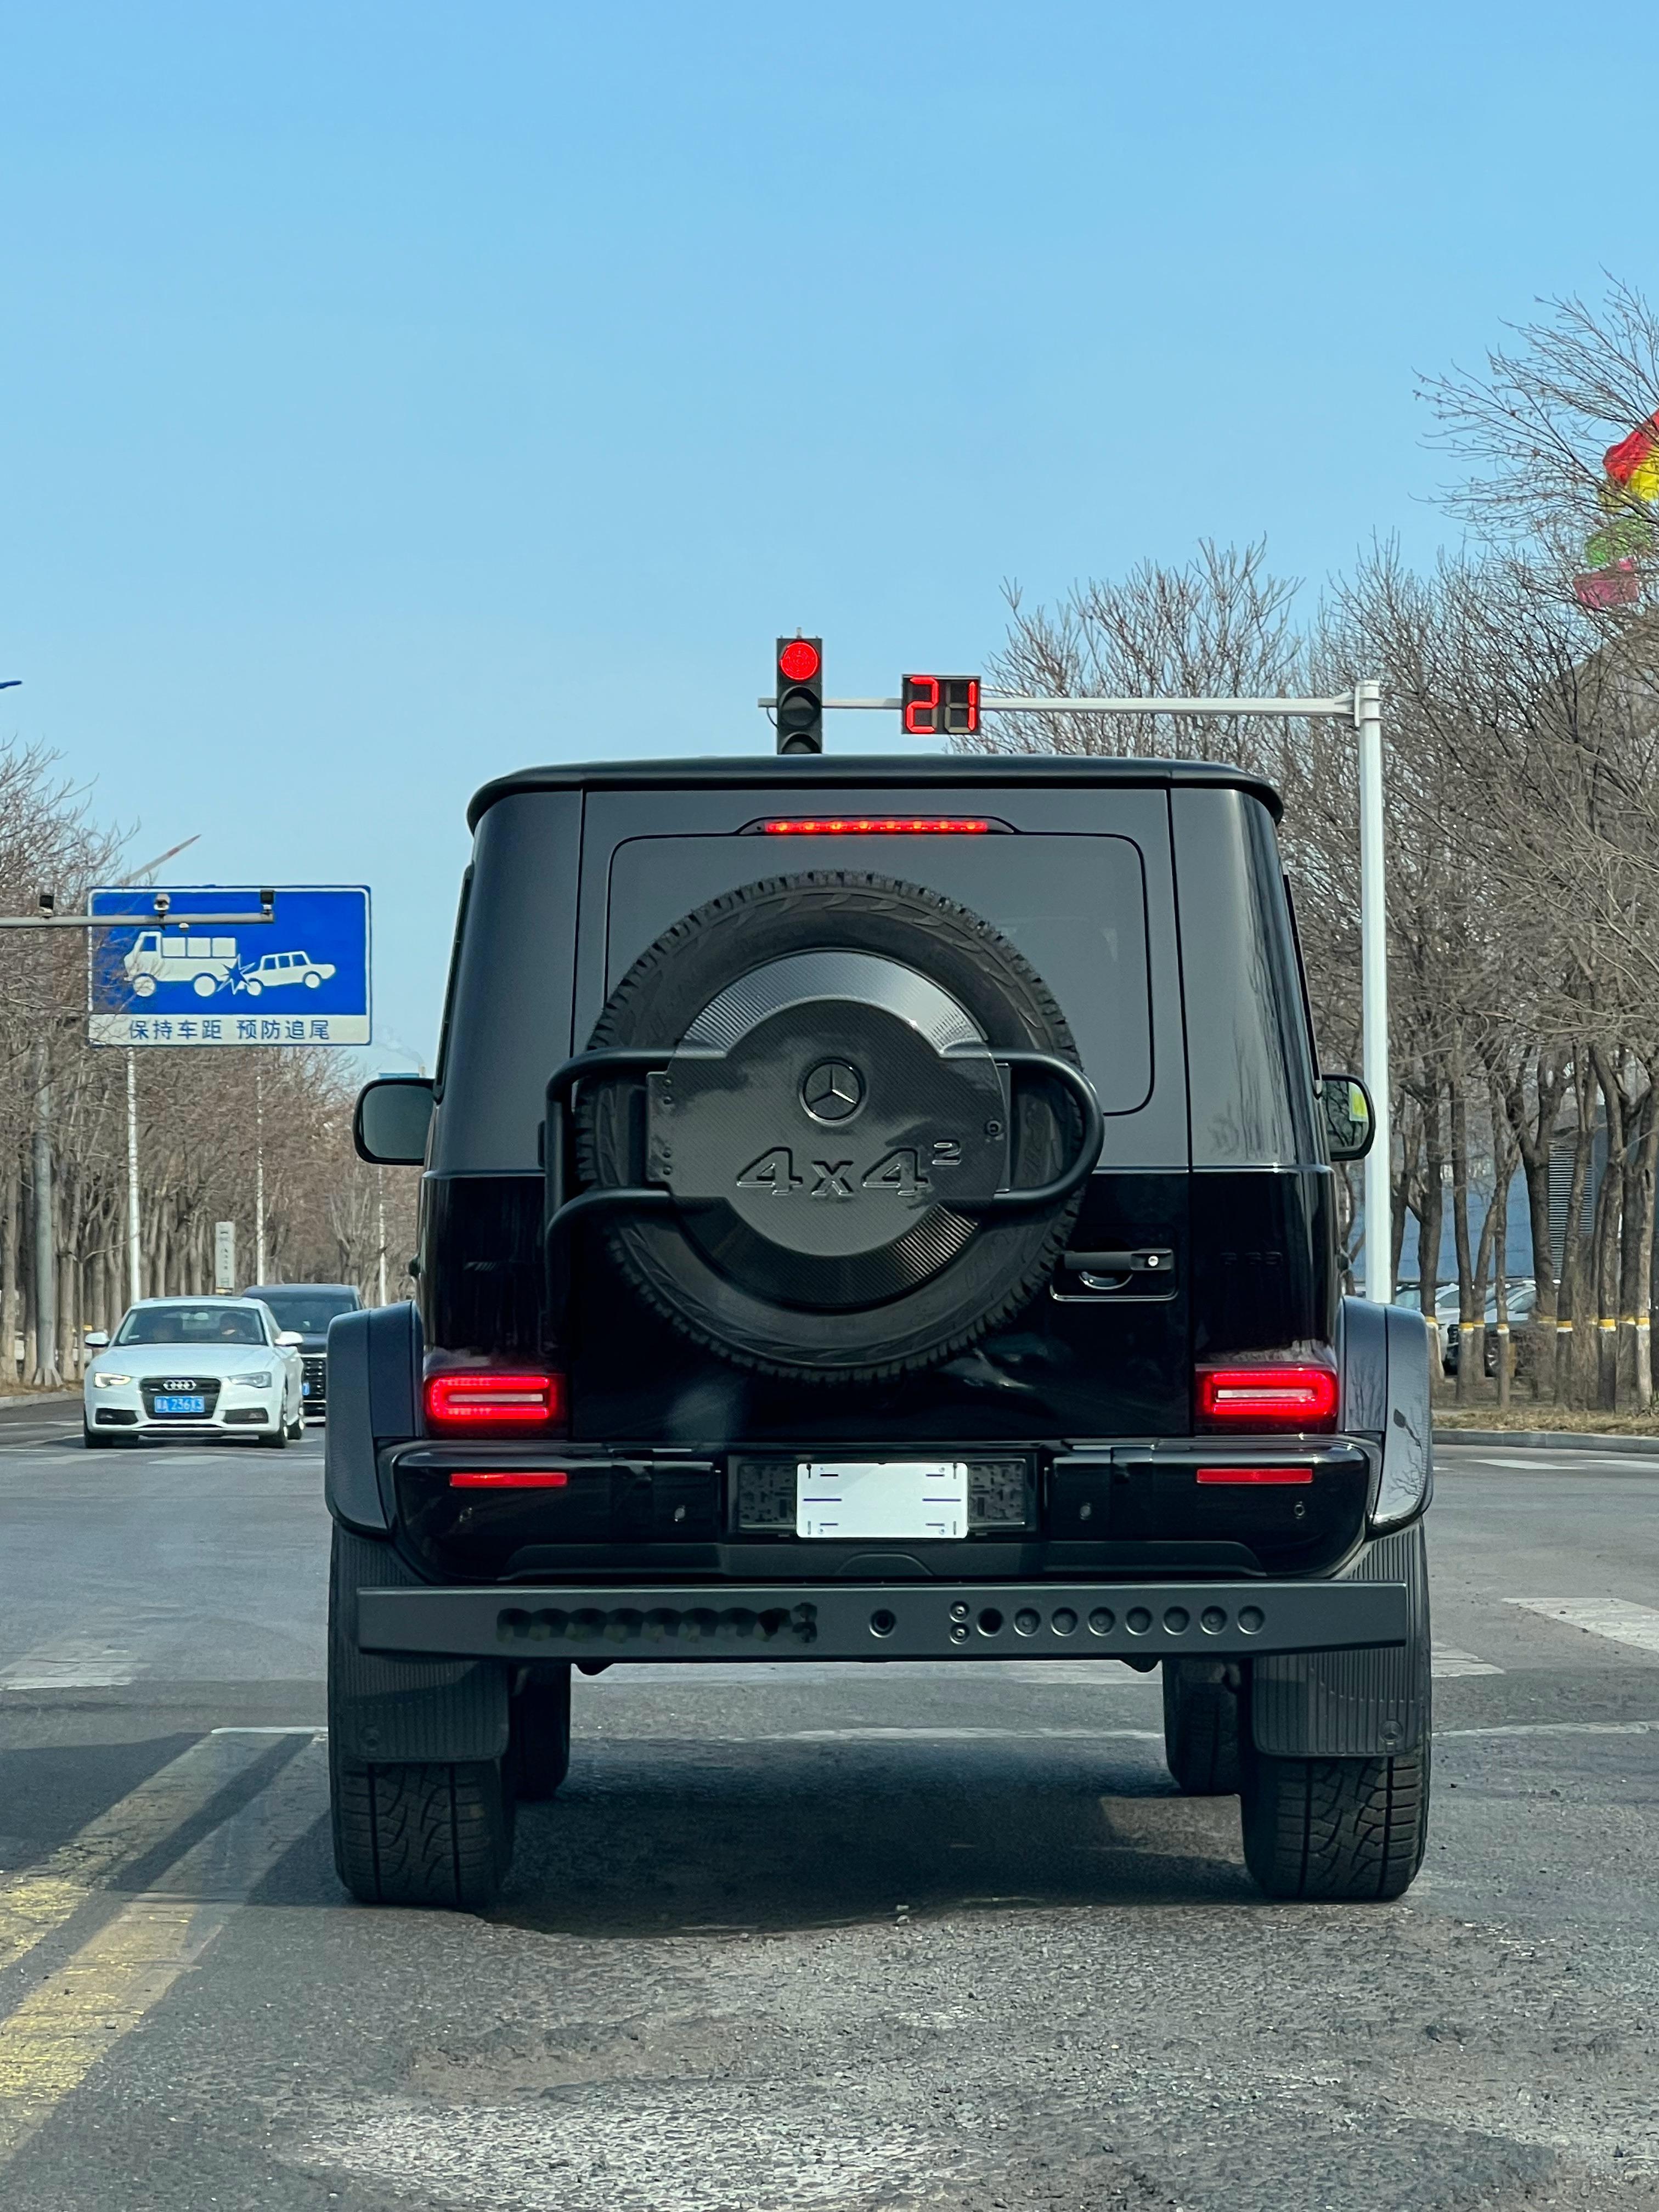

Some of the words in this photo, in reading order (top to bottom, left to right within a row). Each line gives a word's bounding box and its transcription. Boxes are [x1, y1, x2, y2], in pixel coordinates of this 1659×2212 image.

[905, 676, 977, 733] 21
[128, 1019, 222, 1040] 保持车距
[236, 1019, 330, 1040] 预防追尾
